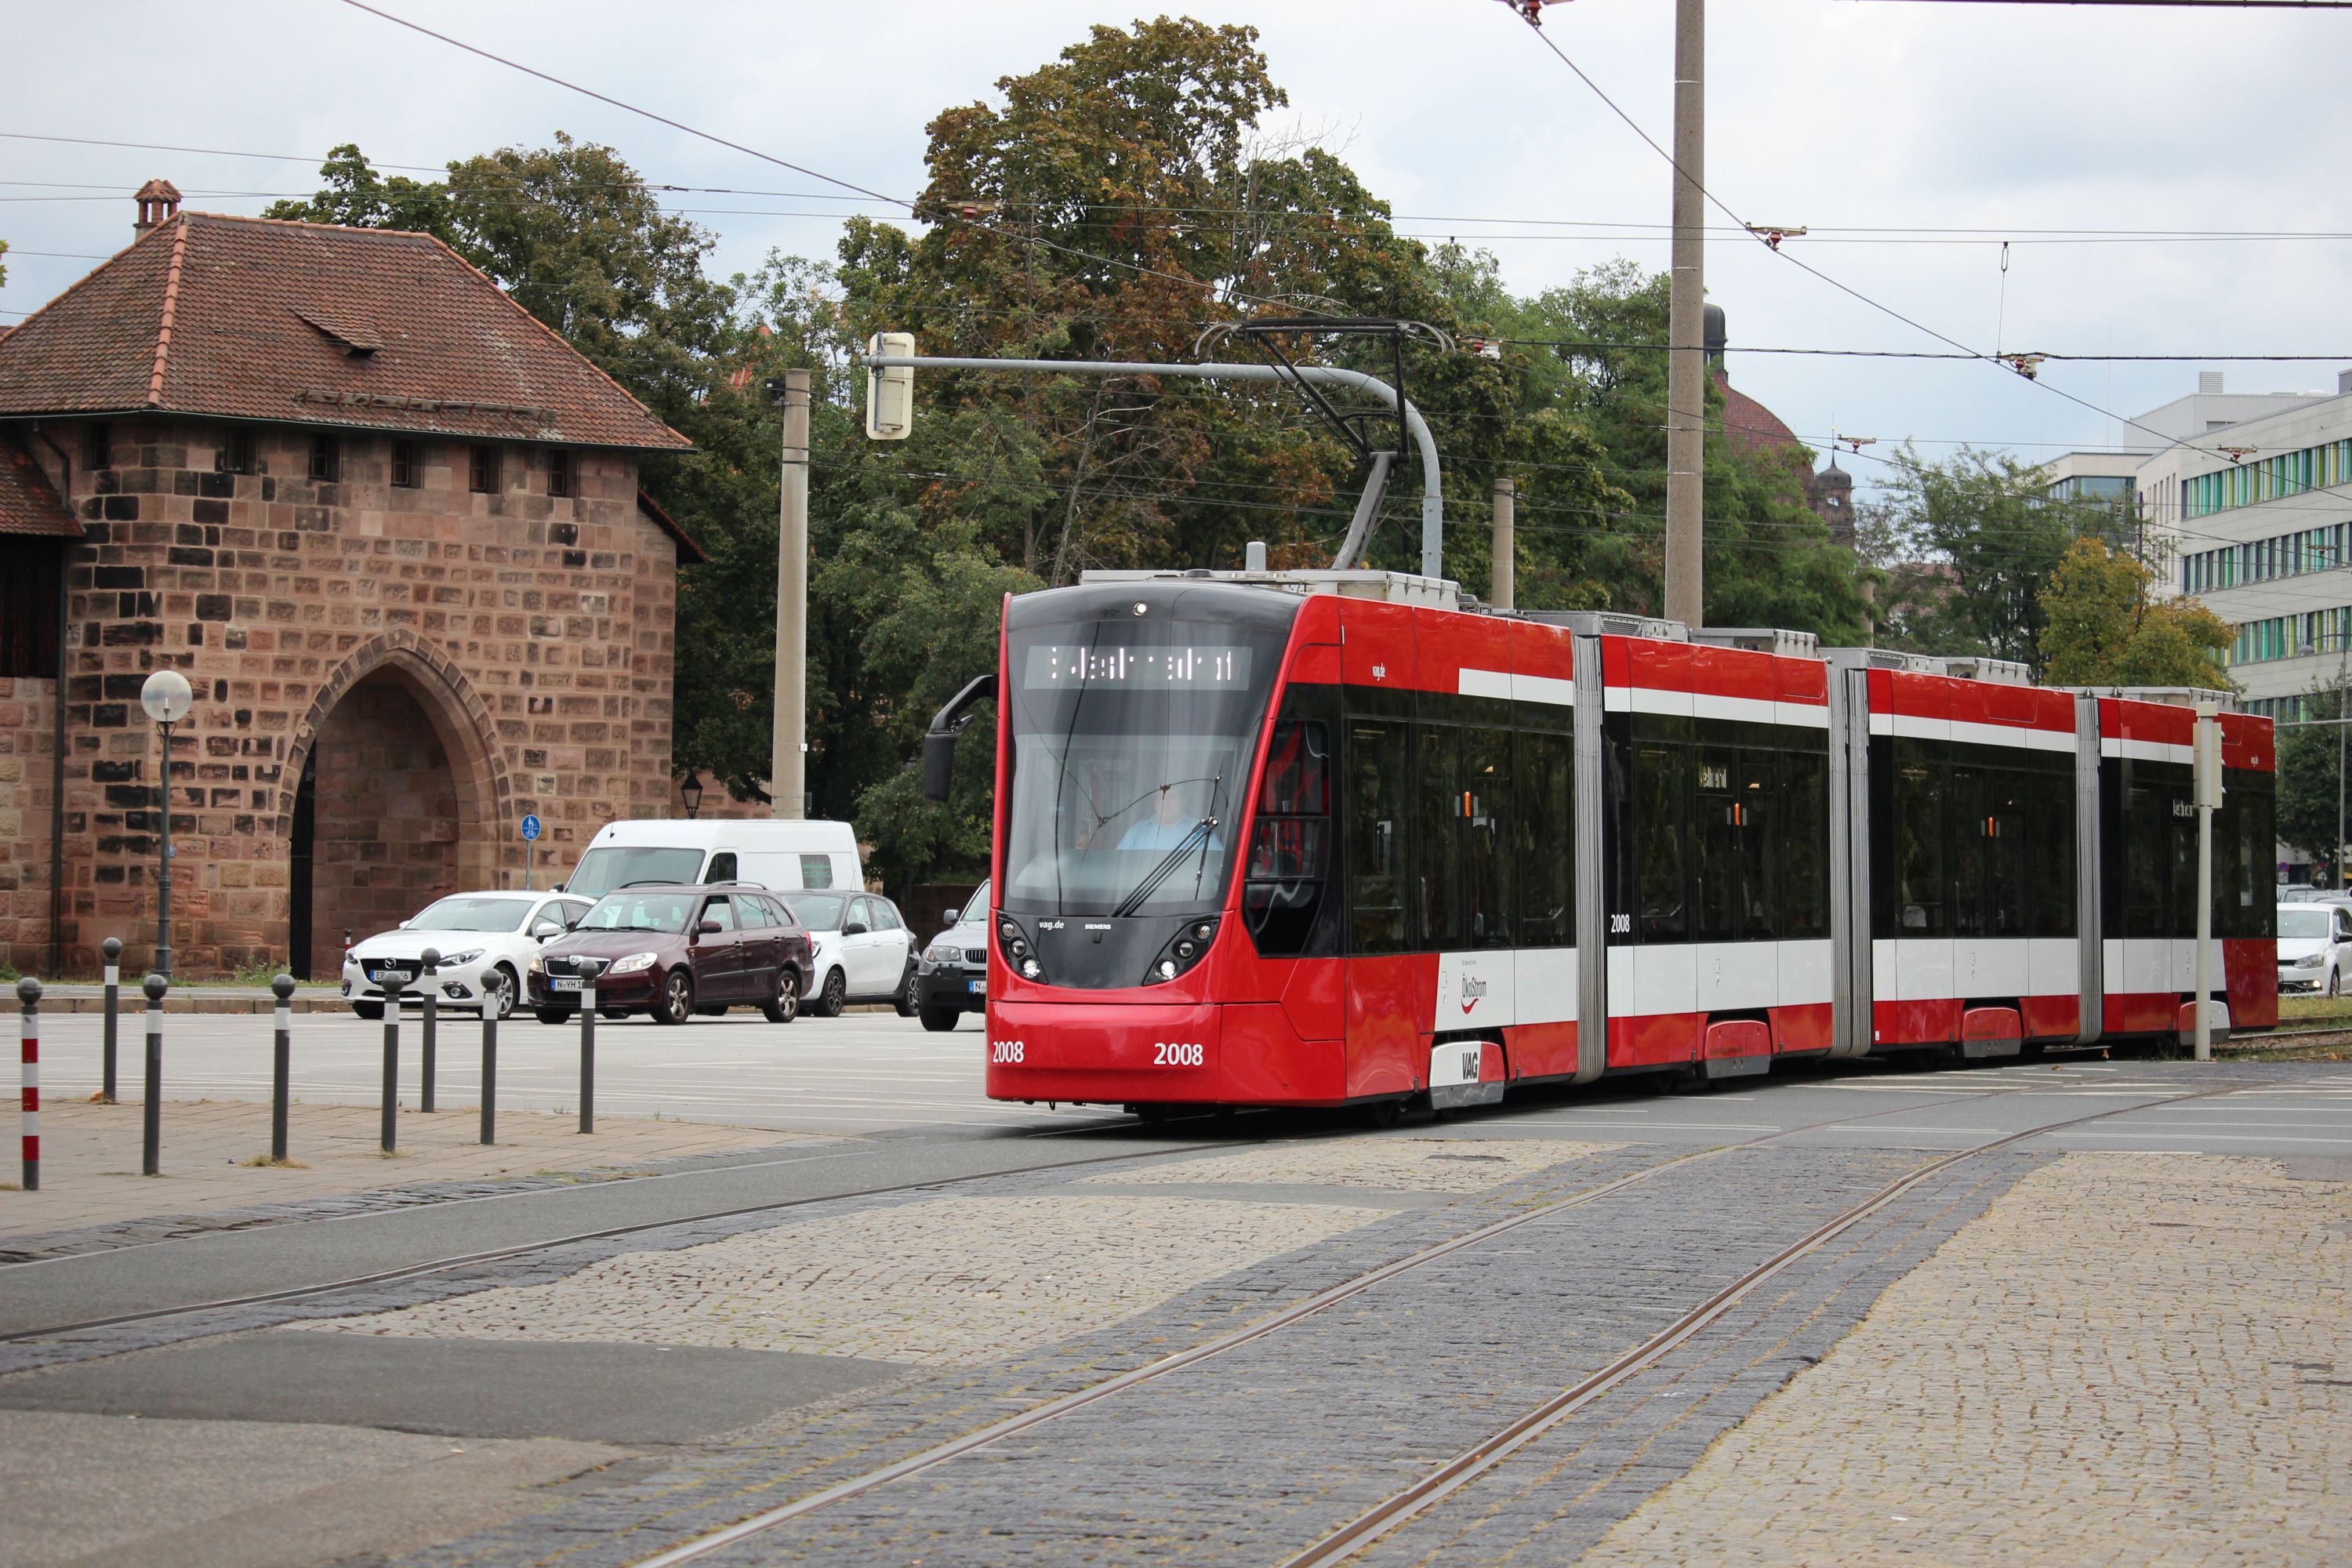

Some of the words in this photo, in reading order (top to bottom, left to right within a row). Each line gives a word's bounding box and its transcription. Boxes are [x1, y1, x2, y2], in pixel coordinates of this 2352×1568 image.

[1039, 920, 1065, 931] vag.de
[1610, 913, 1631, 933] 2008
[1461, 972, 1487, 998] ÖkoStrom
[993, 1040, 1025, 1064] 2008
[1153, 1043, 1204, 1066] 2008
[1462, 1051, 1479, 1080] VAG
